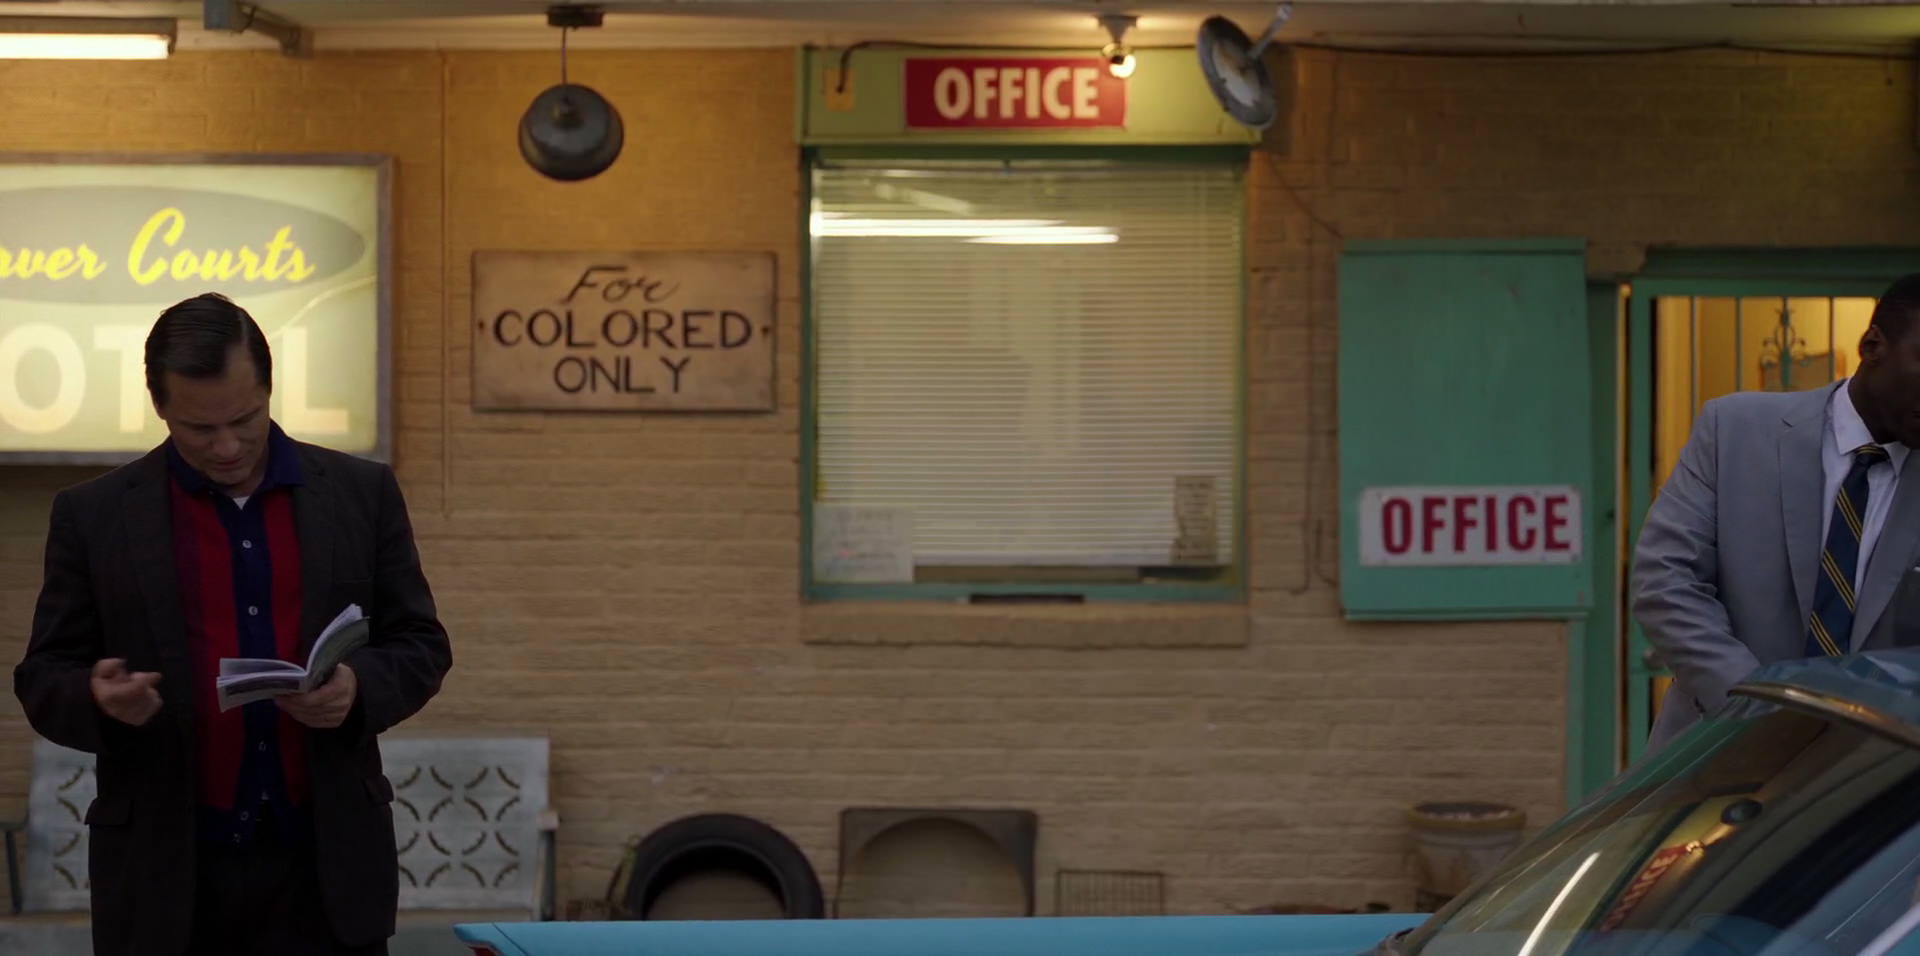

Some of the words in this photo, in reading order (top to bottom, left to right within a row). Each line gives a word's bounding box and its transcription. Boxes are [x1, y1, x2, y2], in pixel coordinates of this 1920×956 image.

[933, 66, 1099, 120] OFFICE
[127, 207, 316, 285] Courts
[559, 265, 681, 305] For
[493, 309, 753, 349] COLORED
[0, 324, 349, 434] OTL
[553, 355, 690, 394] ONLY
[1381, 494, 1571, 555] OFFICE
